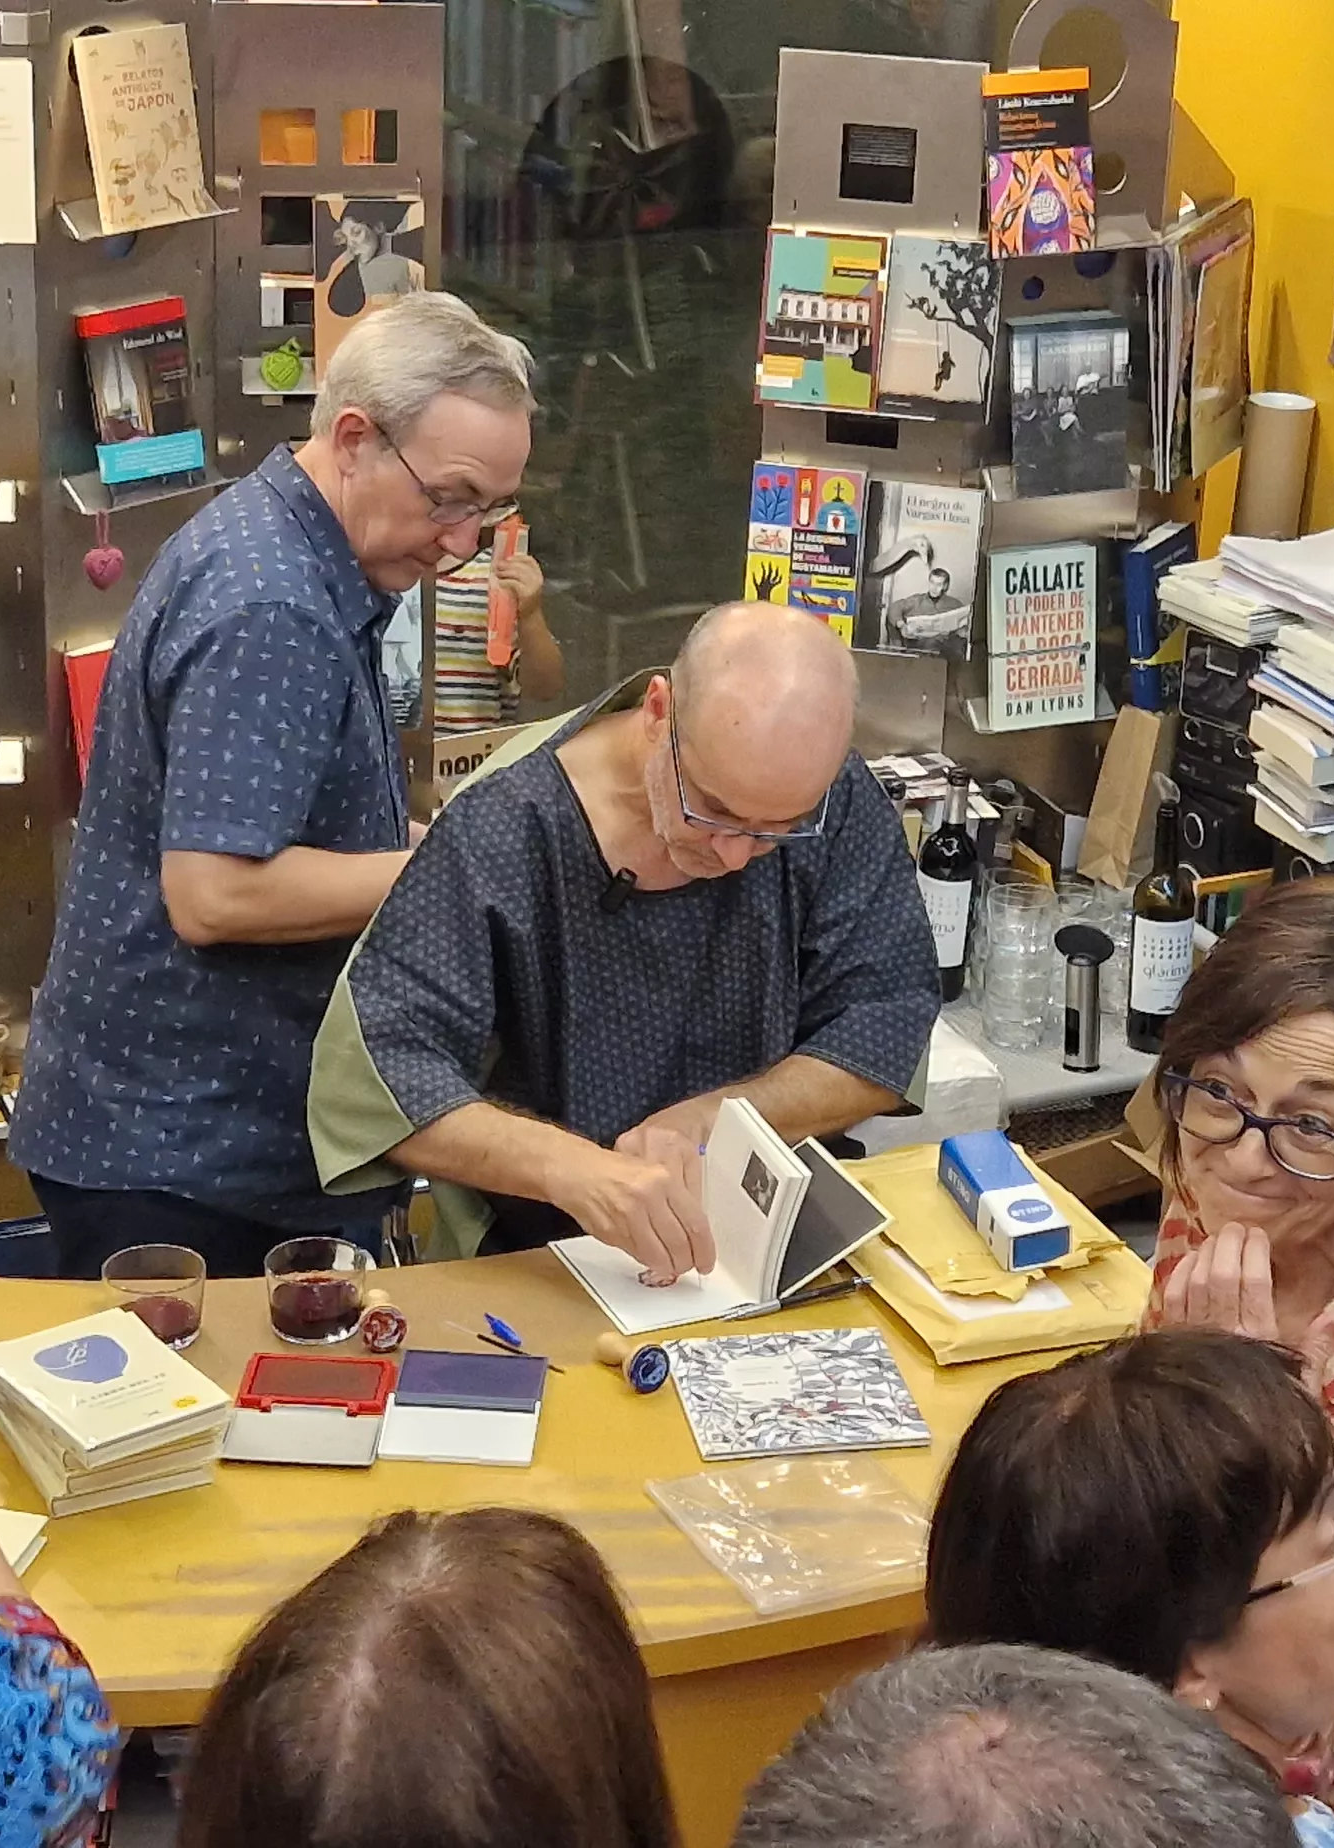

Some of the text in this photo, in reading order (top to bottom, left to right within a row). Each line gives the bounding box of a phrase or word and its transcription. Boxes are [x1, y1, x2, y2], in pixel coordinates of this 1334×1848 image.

[917, 498, 949, 512] negro
[1005, 560, 1085, 596] CÁLLATE
[1005, 590, 1084, 615] EL PODER DE
[1005, 610, 1085, 638] MANTENER
[1006, 638, 1028, 666] LA
[1006, 661, 1084, 692] CERRADA
[1006, 693, 1084, 717] DAN LYONS
